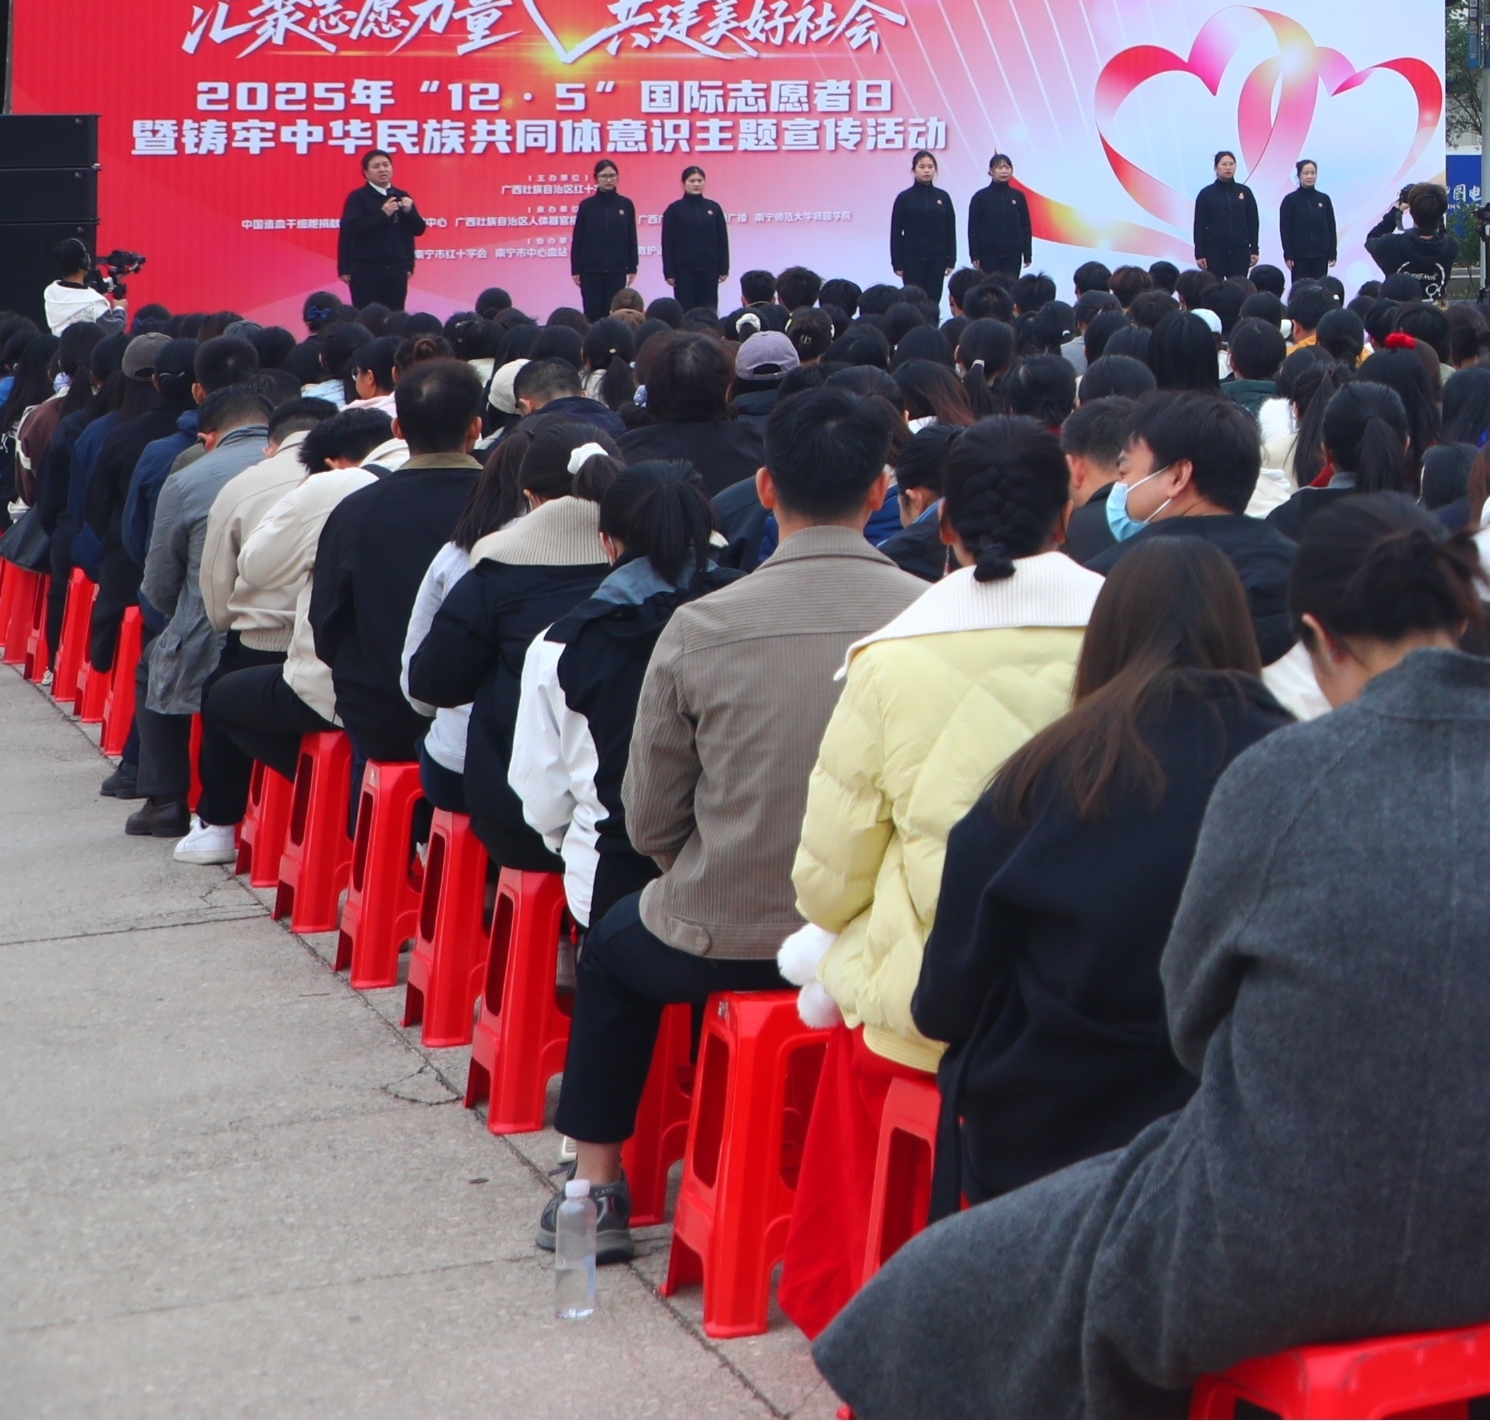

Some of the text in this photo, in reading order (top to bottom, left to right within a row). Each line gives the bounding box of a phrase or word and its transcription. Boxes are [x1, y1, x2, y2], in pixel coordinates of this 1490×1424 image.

[197, 79, 395, 115] 2025年
[641, 79, 892, 115] 国际志愿者日
[131, 117, 949, 156] 暨铸牢中华民族共同体意识主题宣传活动
